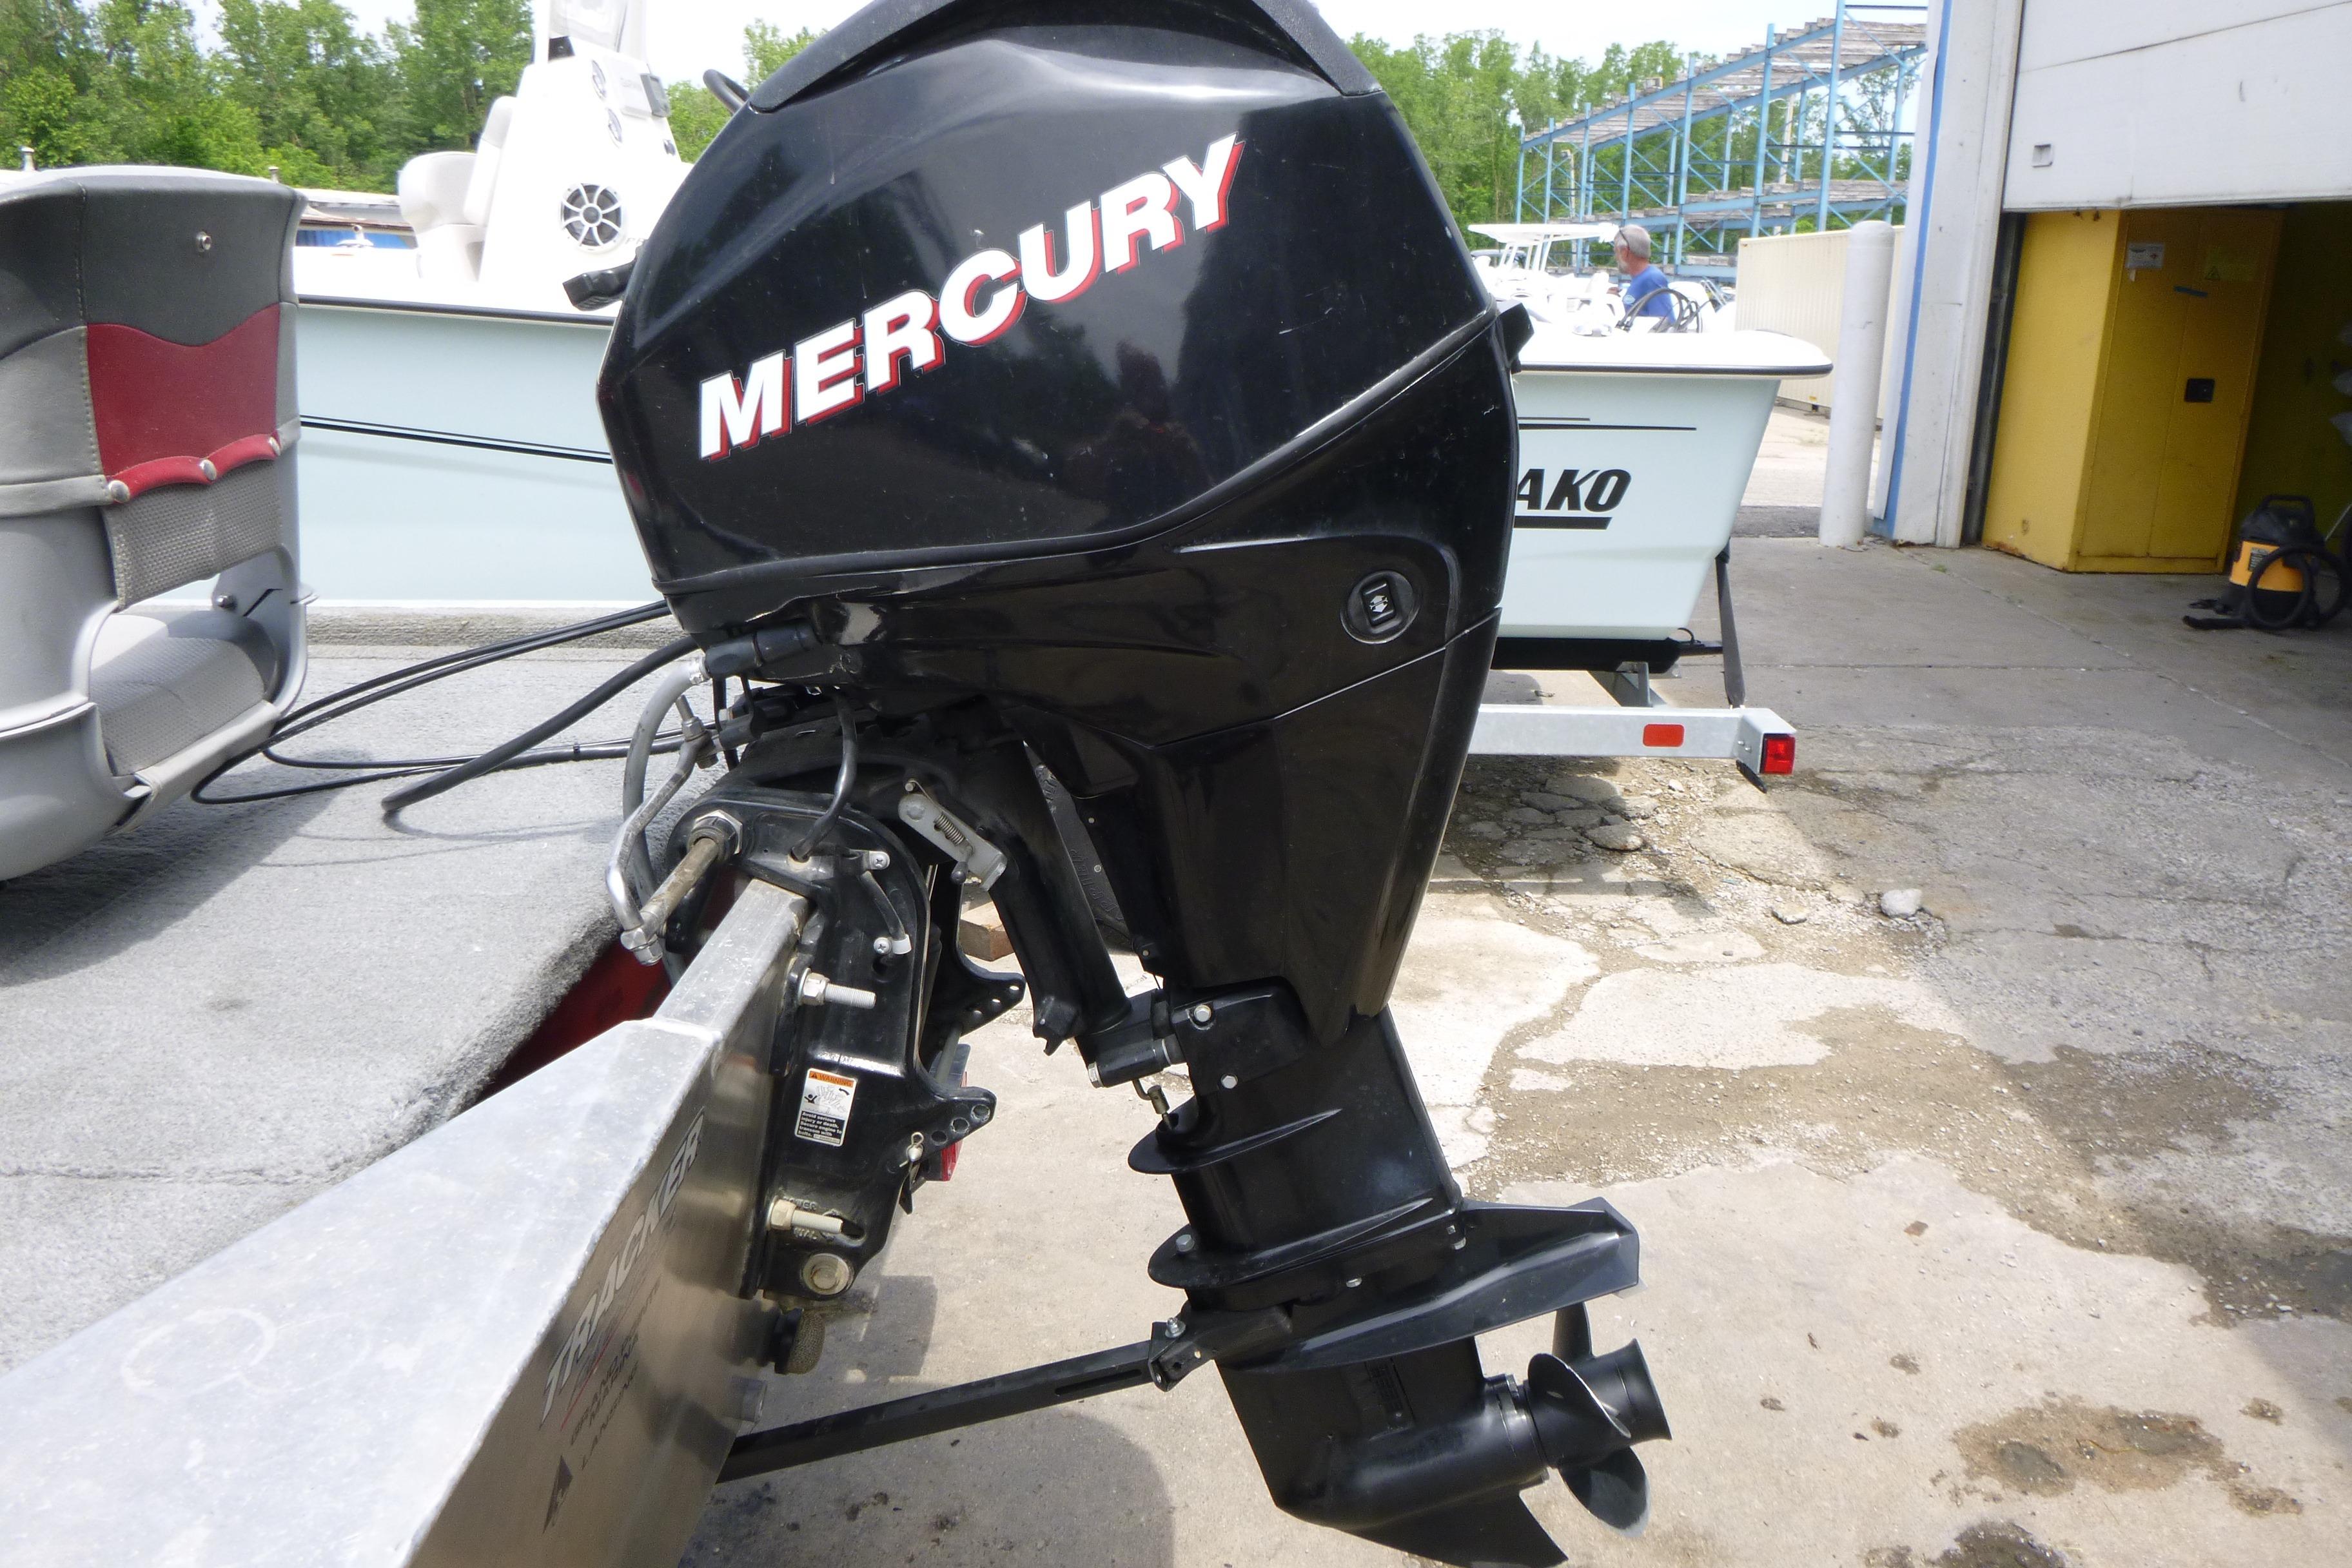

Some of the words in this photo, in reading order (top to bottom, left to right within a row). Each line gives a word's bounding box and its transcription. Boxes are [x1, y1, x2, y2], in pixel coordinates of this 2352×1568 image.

[699, 132, 1245, 462] MERCURY
[819, 1073, 852, 1086] WARNING
[539, 1106, 704, 1429] TRACKER
